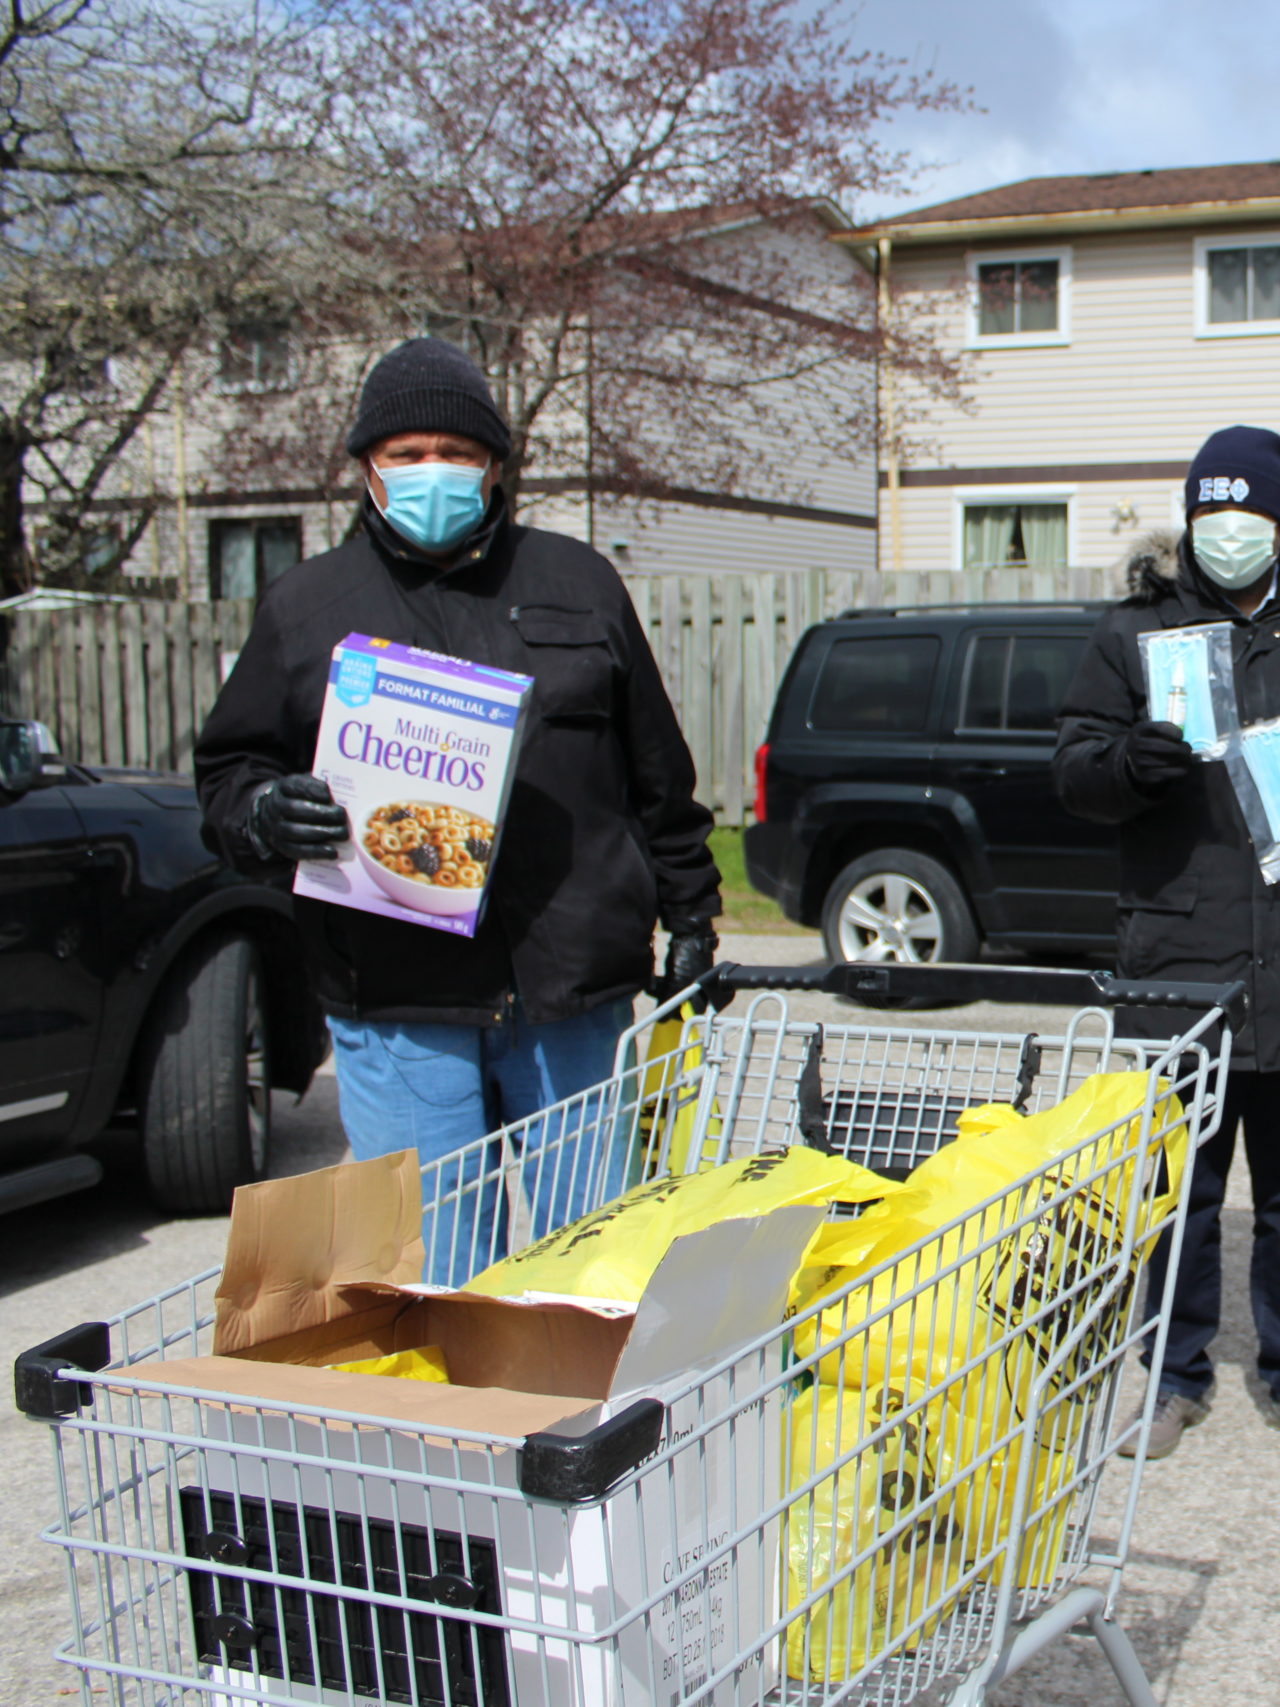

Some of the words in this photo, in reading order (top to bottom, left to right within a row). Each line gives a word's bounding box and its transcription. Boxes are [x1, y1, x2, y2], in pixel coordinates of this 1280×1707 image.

[378, 678, 430, 701] FORMAT
[430, 692, 485, 717] FAMILIAL
[337, 720, 485, 791] Cheerios
[394, 718, 440, 745] Multi
[444, 731, 491, 757] Grain
[693, 1531, 728, 1564] SPING
[663, 1643, 692, 1681] BOTED
